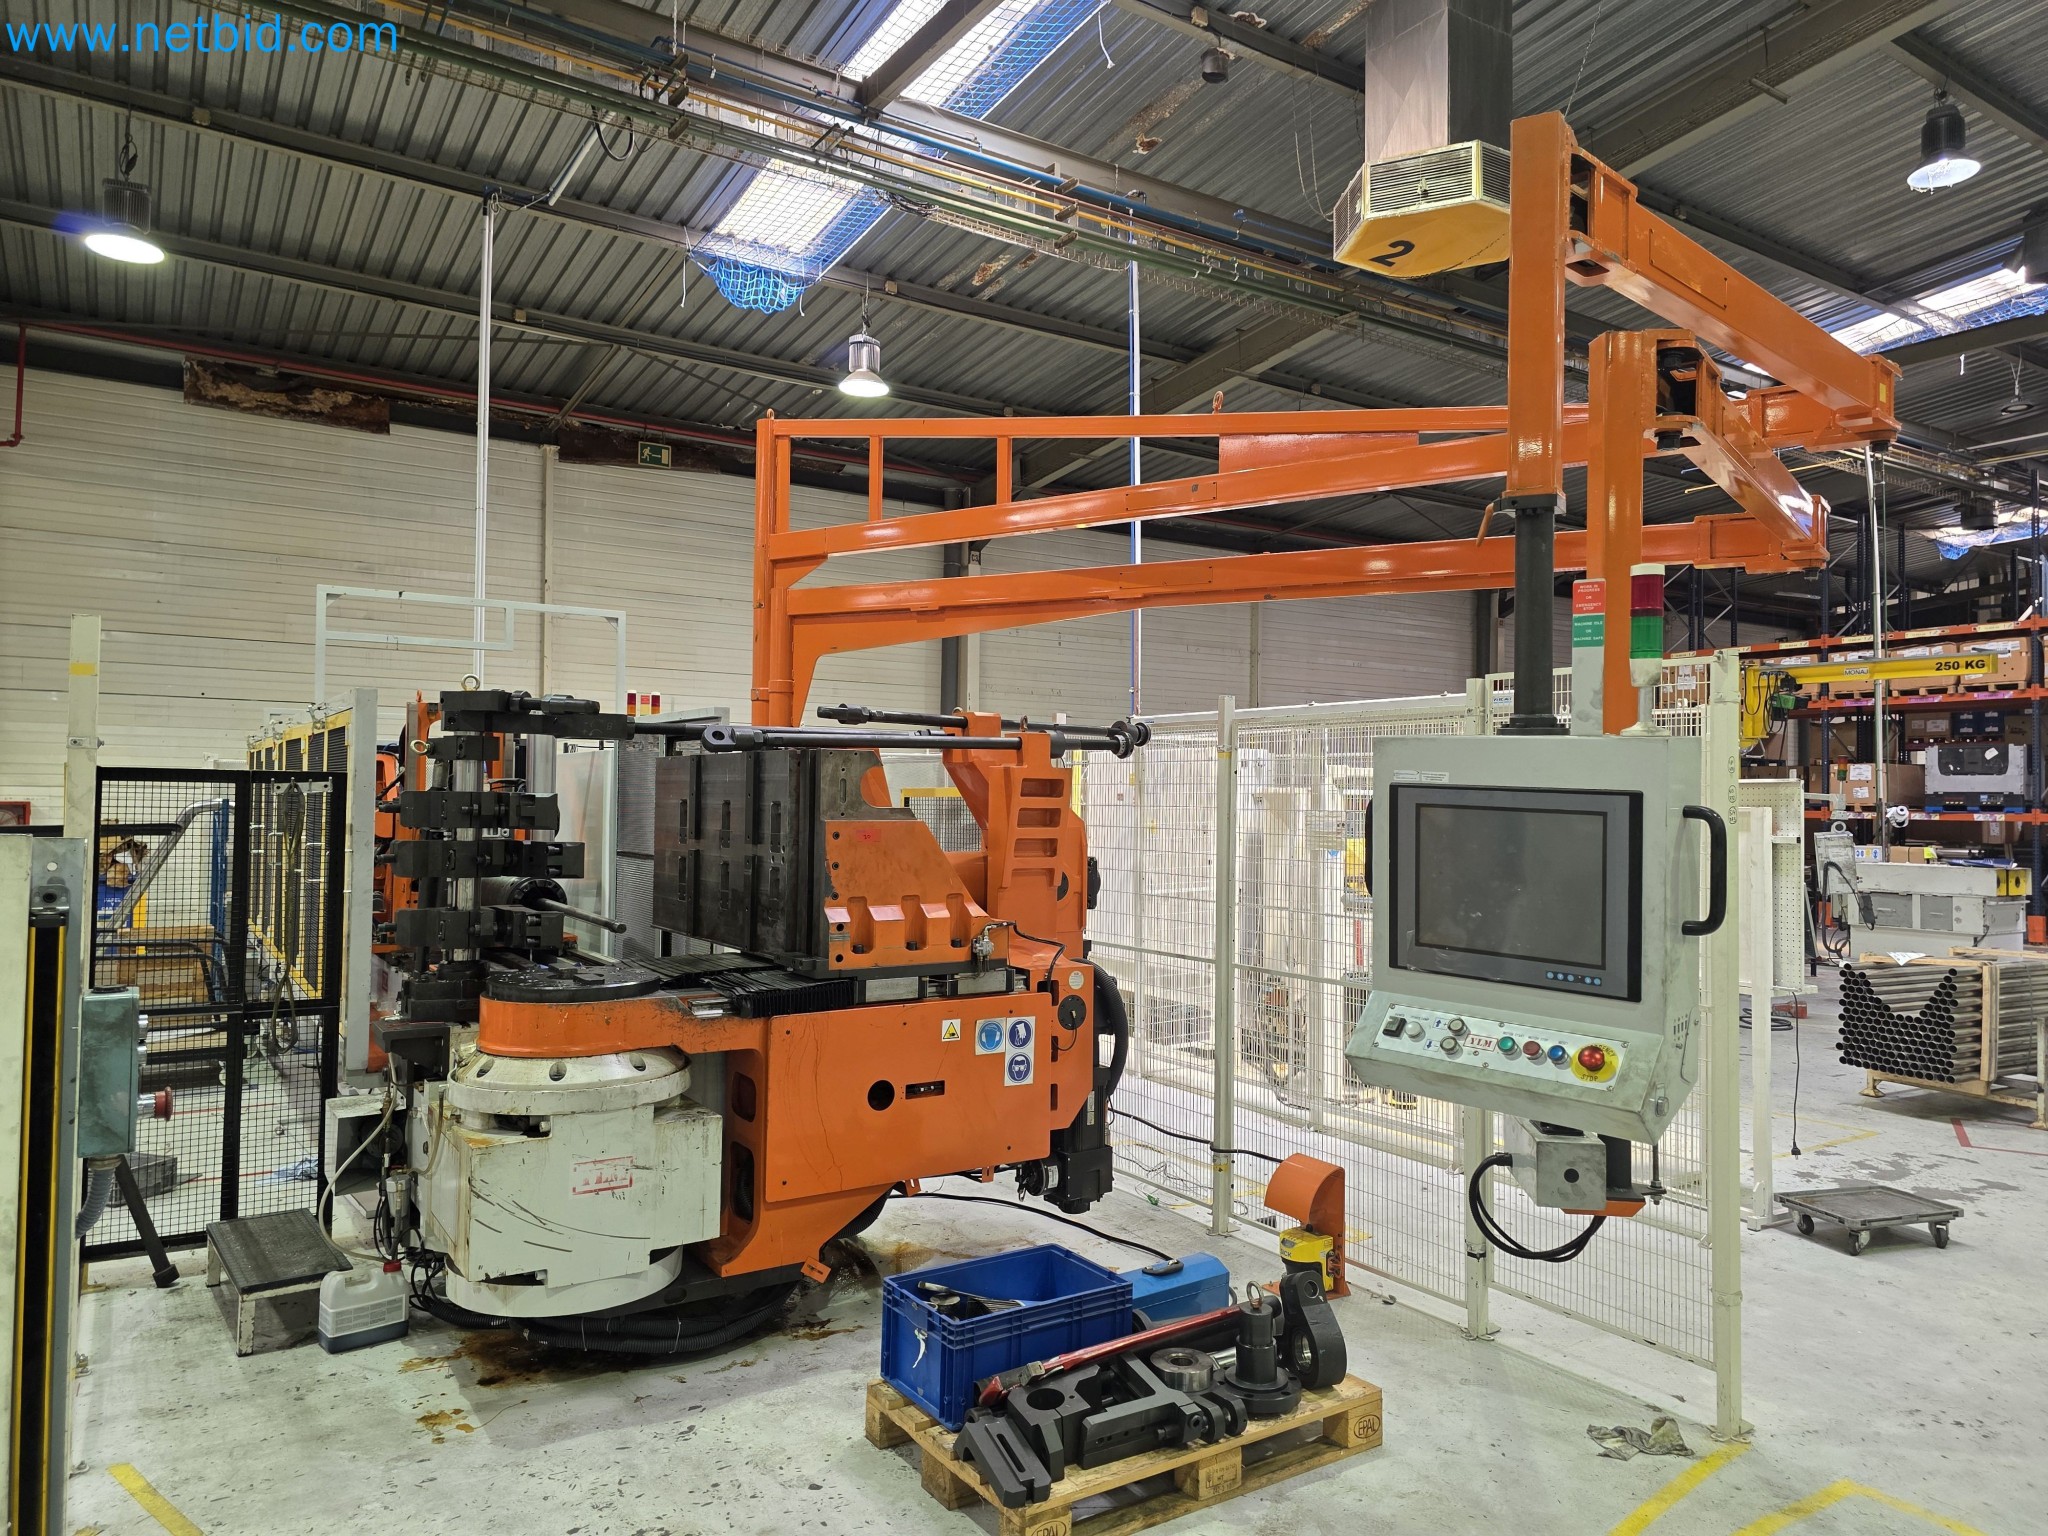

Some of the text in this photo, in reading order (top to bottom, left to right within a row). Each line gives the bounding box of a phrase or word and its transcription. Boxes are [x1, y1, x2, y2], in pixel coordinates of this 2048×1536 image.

[1368, 240, 1415, 267] 2
[1935, 659, 1986, 671] 250 KG
[1470, 1037, 1492, 1047] YLM
[1580, 1073, 1599, 1082] STOP
[1358, 1417, 1377, 1437] EPAL
